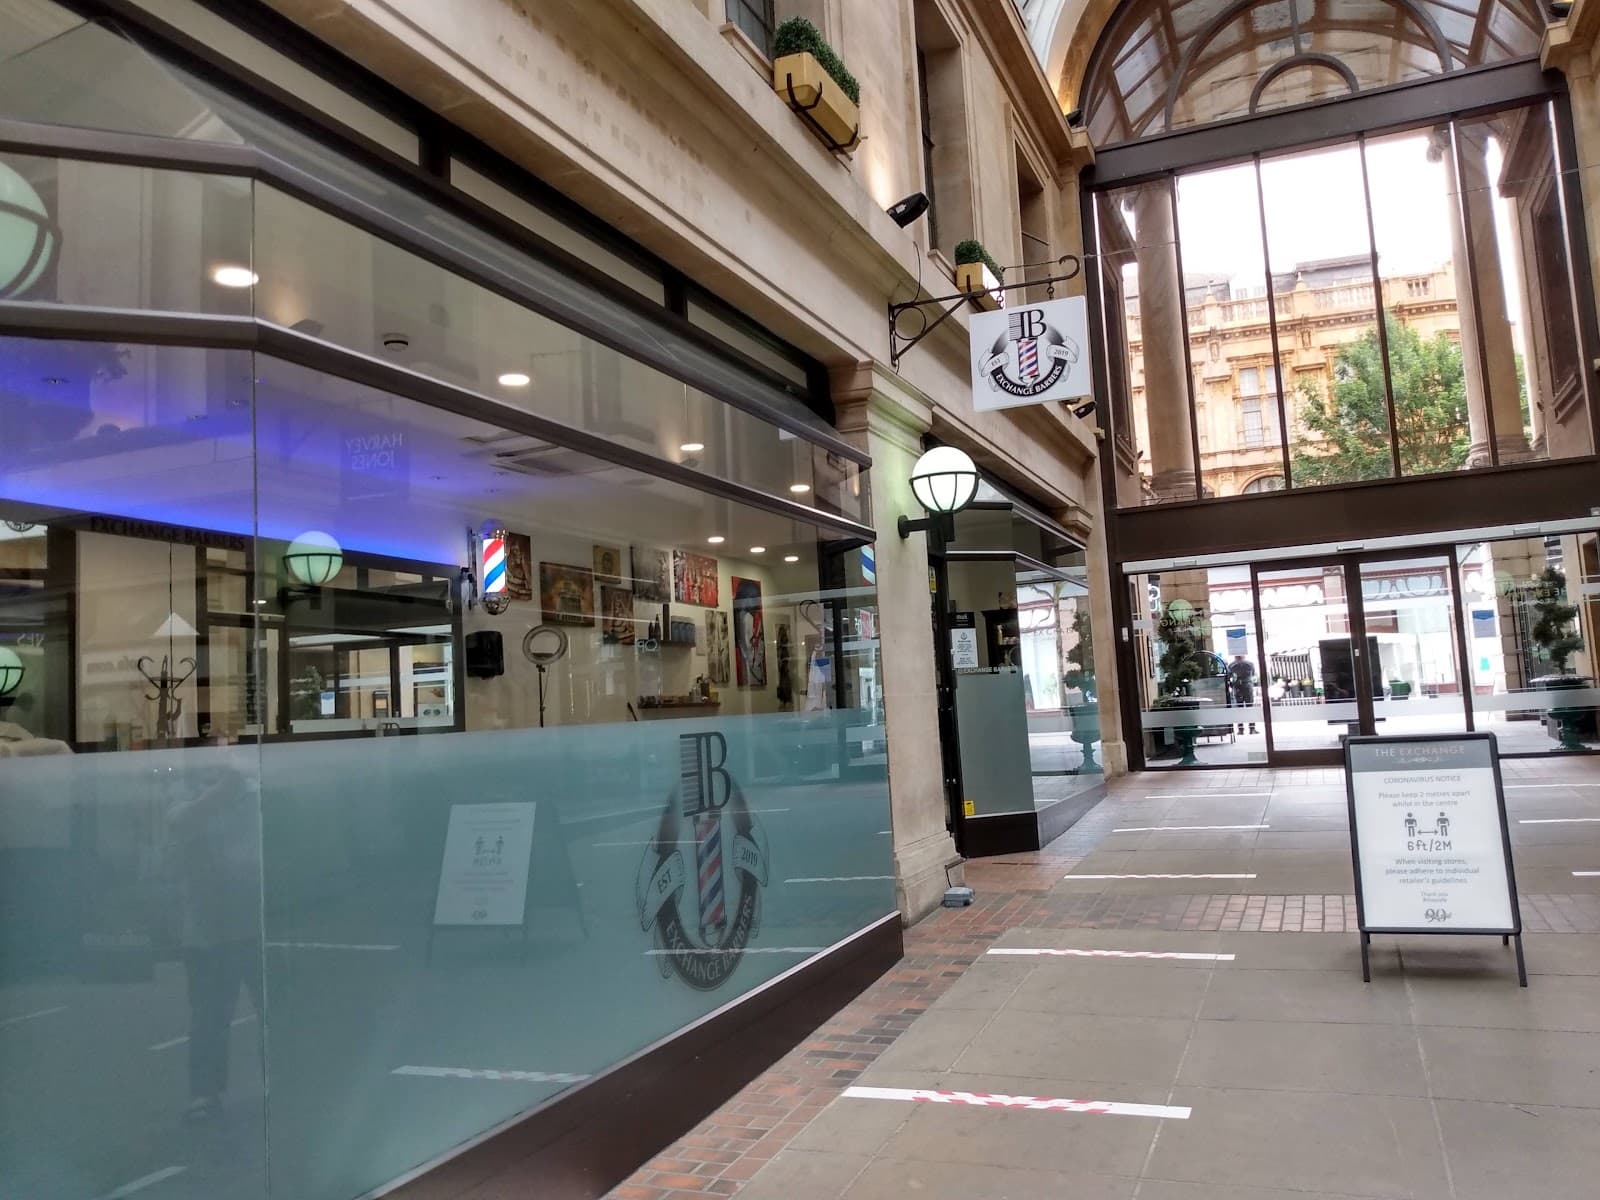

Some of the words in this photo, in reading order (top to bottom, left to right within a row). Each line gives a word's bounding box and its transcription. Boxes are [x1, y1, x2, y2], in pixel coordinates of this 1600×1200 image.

[1053, 348, 1069, 357] 2019
[995, 374, 1034, 395] EXCHANGE
[1035, 366, 1063, 392] BARBERS
[89, 515, 182, 542] EXCHANGE
[1375, 747, 1396, 757] THE
[1399, 745, 1465, 756] EXCHANGE
[1383, 776, 1433, 784] CORONAVIRUS
[1401, 791, 1418, 799] keep
[1452, 790, 1470, 798] apart
[1407, 839, 1452, 852] 6ft/2M
[740, 848, 759, 866] 2019
[1417, 858, 1442, 866] visiting
[1385, 868, 1407, 876] please
[657, 869, 673, 896] EST
[1432, 878, 1468, 886] guidelines
[666, 919, 722, 981] EXCHANGE
[721, 895, 754, 972] BARBERS
